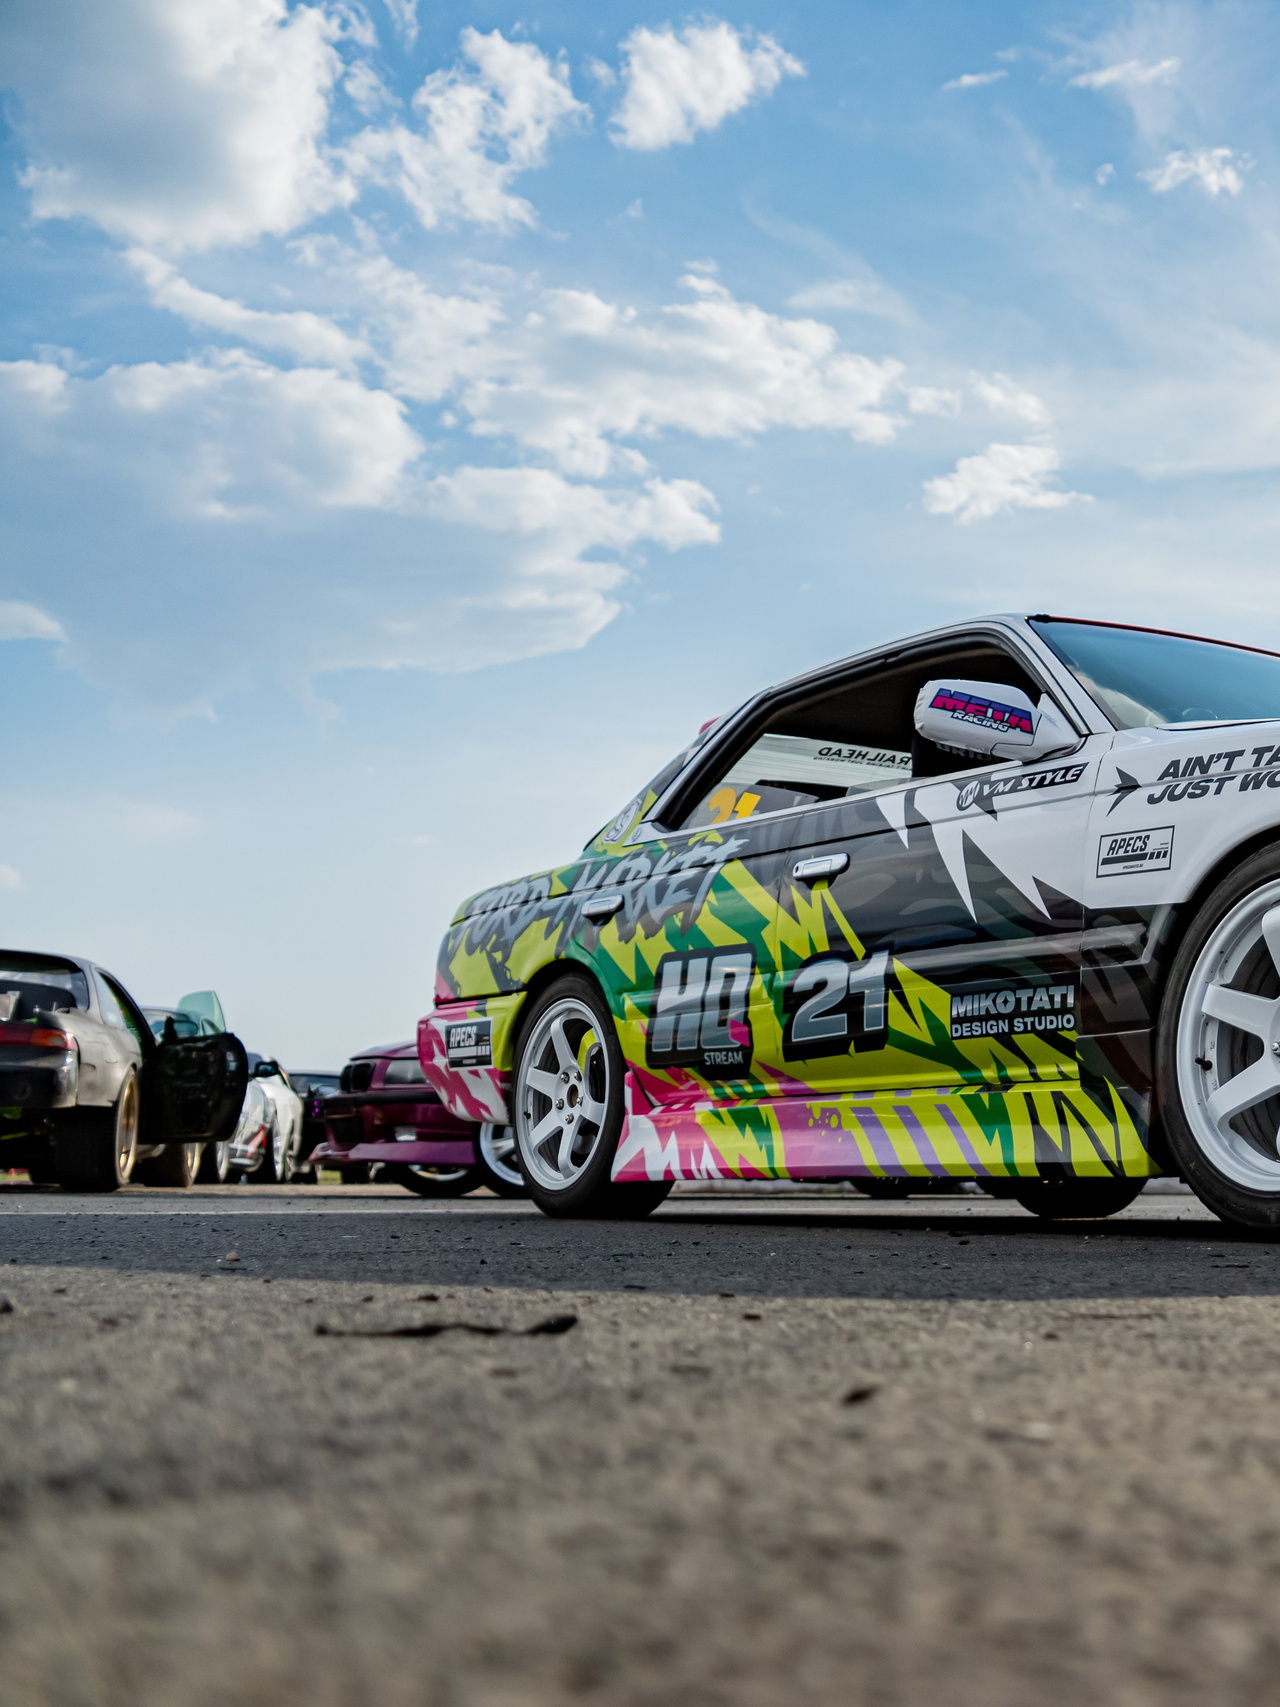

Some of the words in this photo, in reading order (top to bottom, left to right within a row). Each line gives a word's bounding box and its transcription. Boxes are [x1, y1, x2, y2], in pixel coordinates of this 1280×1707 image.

[930, 688, 1034, 735] META
[952, 710, 1010, 732] RACING
[1017, 765, 1084, 790] STYLE
[1157, 749, 1246, 781] AIN'T
[1146, 775, 1239, 804] JUST
[1107, 834, 1150, 856] APECS
[791, 949, 889, 1043] 21
[951, 984, 1075, 1019] MIKOTATI
[450, 1025, 477, 1047] APECS
[951, 1019, 1009, 1037] DESIGN
[1013, 1013, 1075, 1032] STUDIO
[704, 1051, 744, 1065] STREAM
